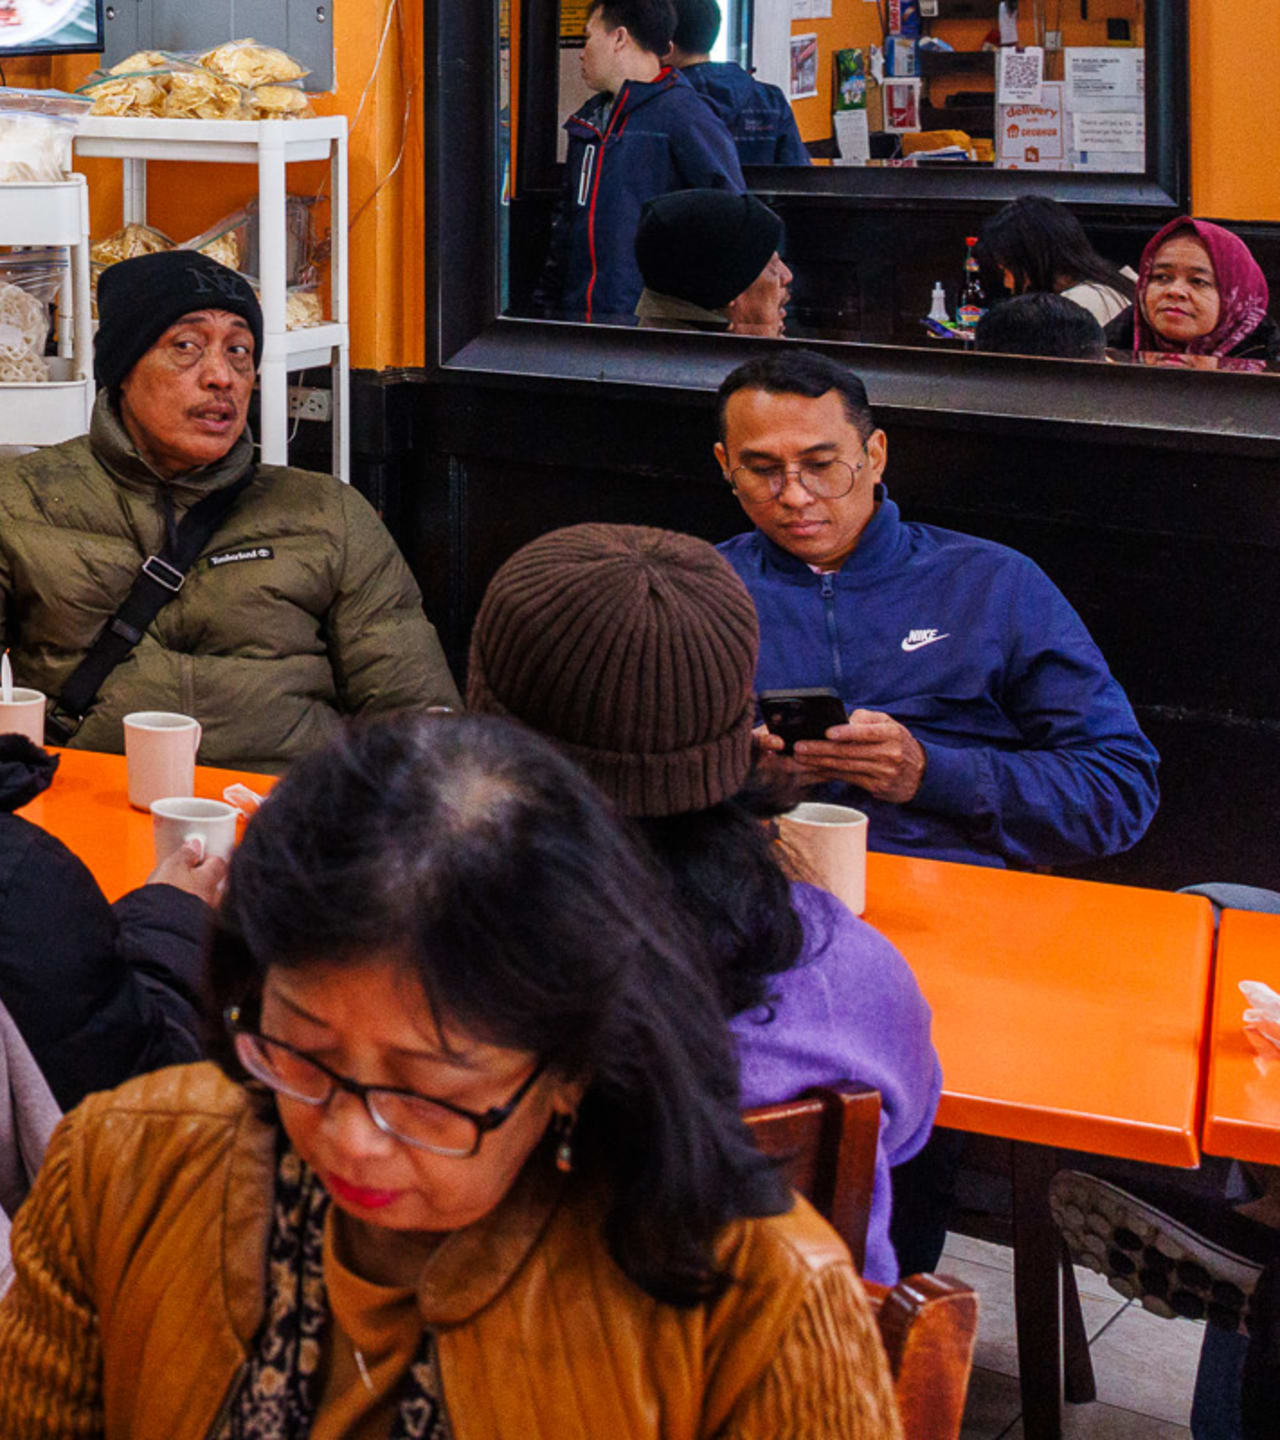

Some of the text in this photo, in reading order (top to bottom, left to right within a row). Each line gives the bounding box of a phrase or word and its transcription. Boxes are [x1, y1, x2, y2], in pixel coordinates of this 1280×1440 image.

[1006, 105, 1058, 119] delivery
[210, 549, 257, 565] Timberland
[909, 628, 939, 643] NIKE
